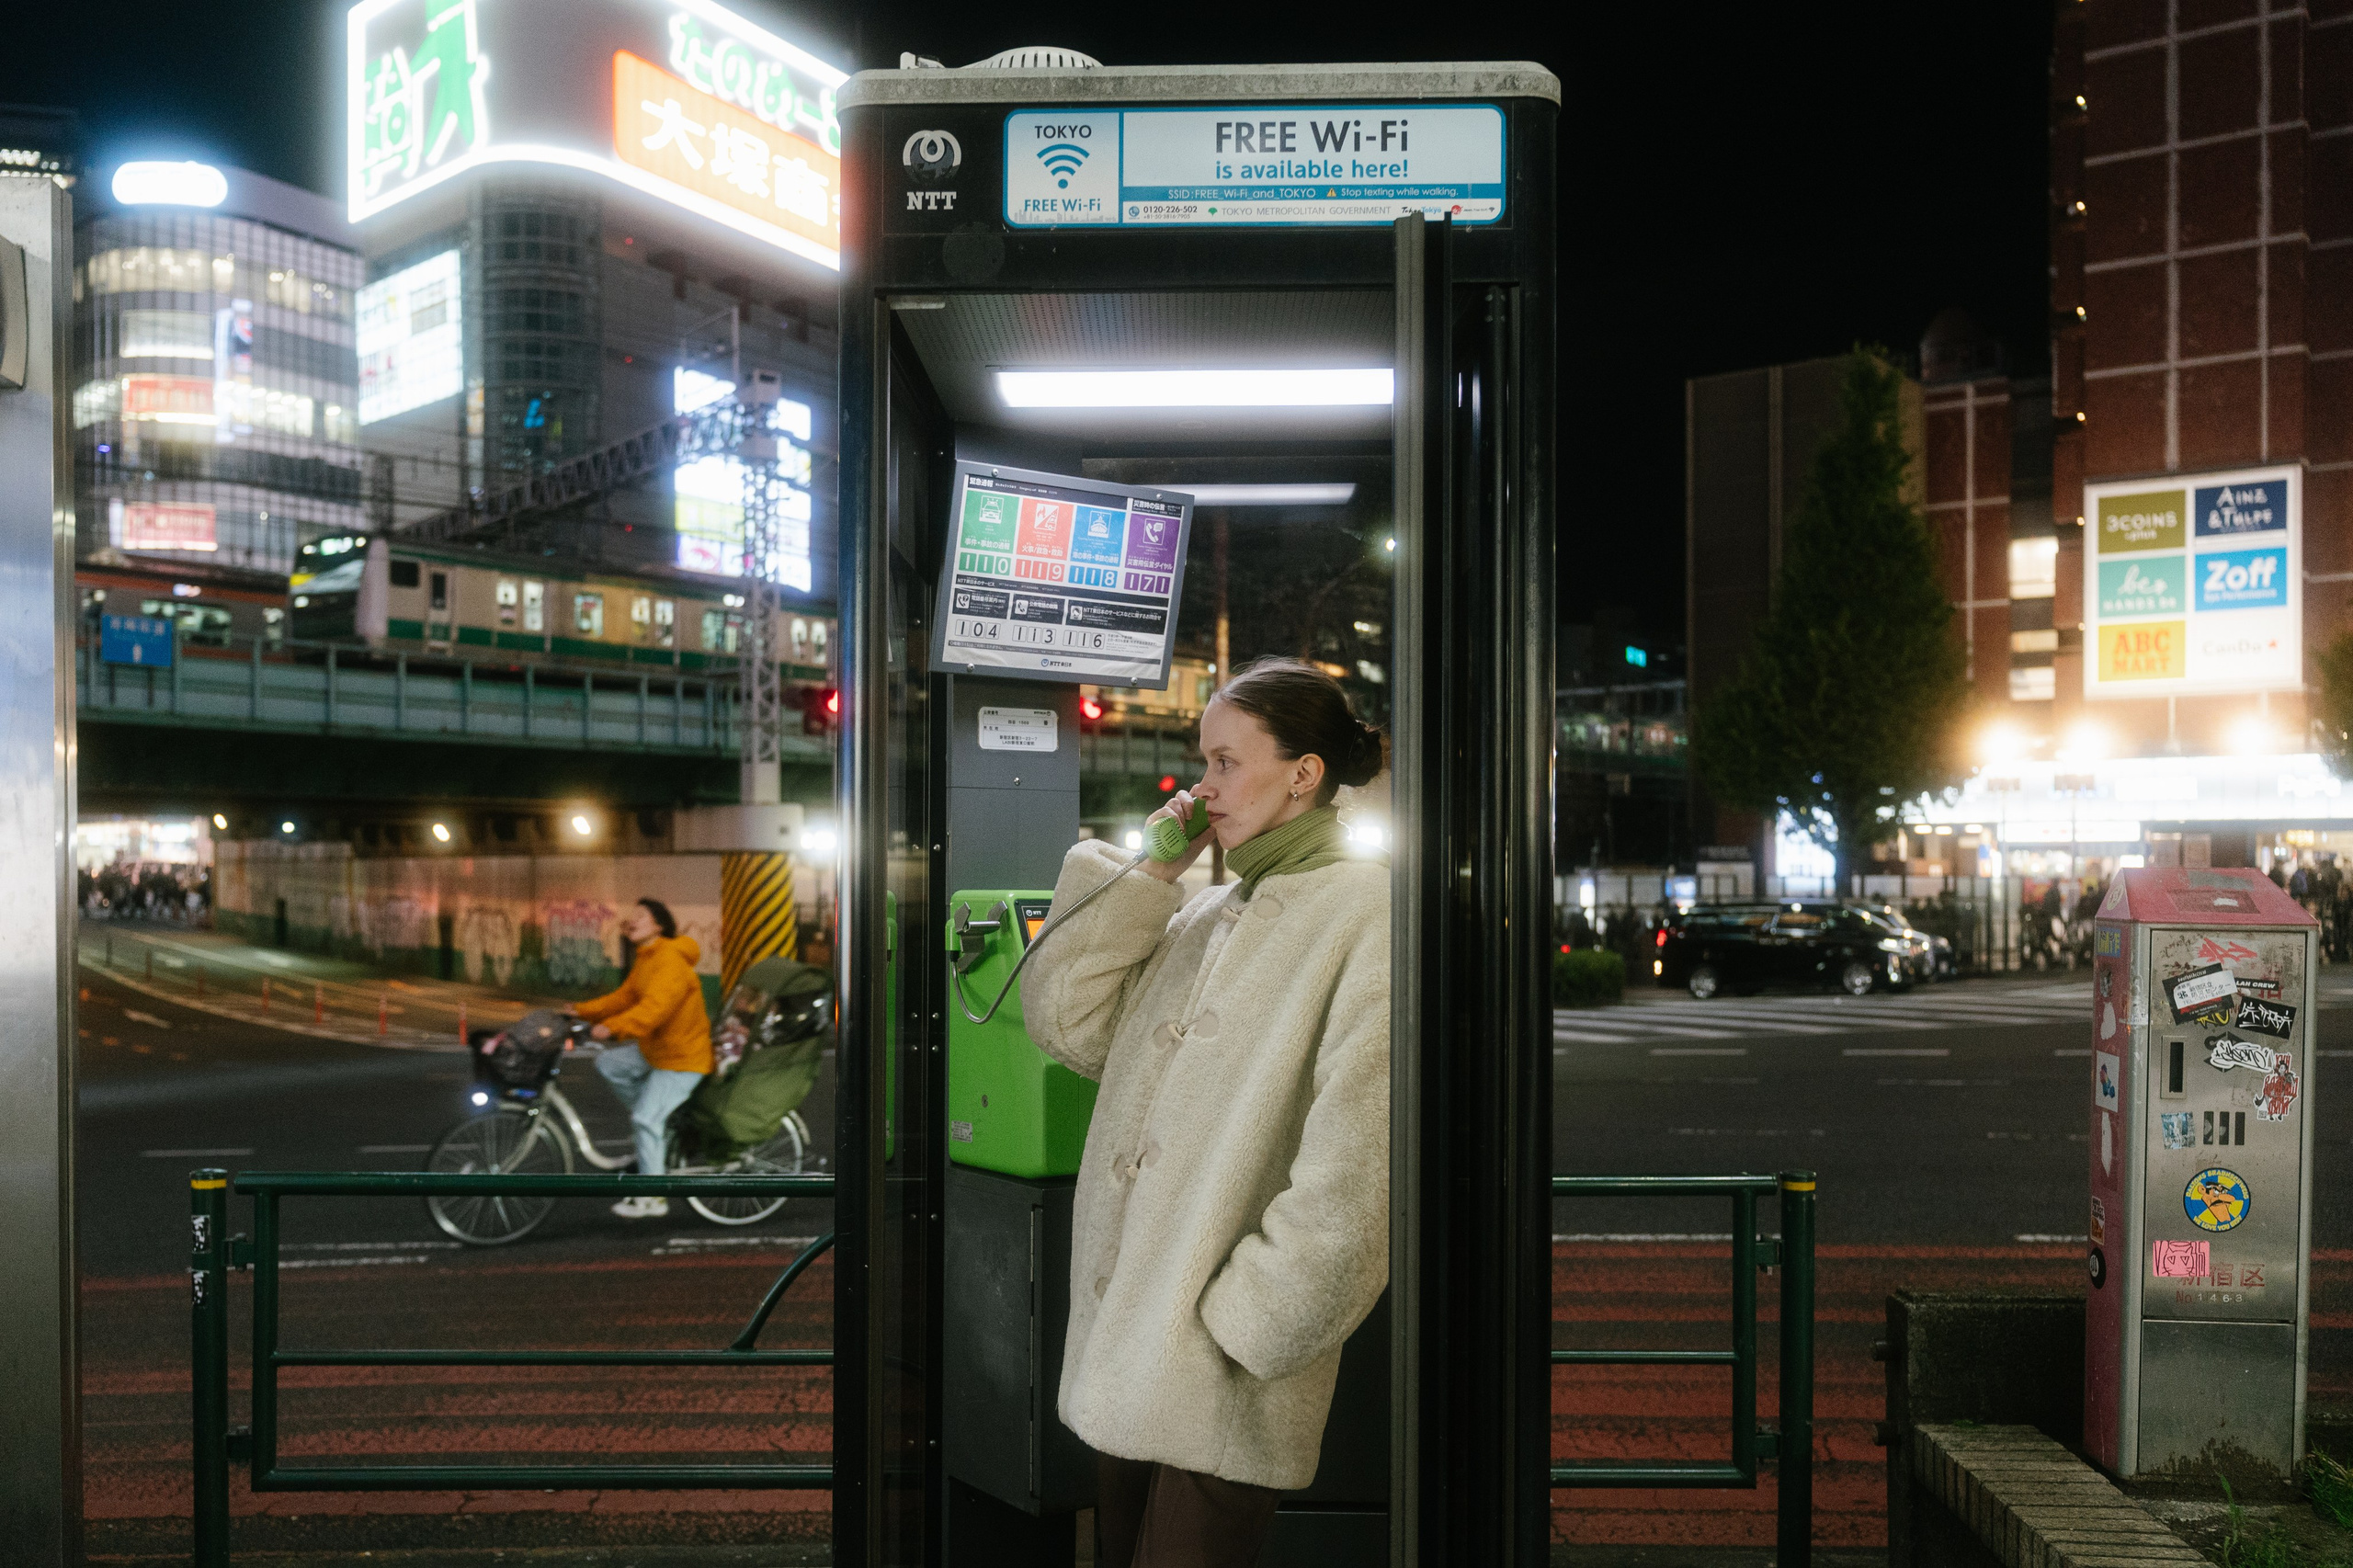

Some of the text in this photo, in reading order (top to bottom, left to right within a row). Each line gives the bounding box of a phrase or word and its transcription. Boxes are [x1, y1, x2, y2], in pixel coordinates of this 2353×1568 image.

[1034, 125, 1092, 139] TOKYO
[1216, 119, 1408, 153] FREE Wi-Fi
[642, 98, 840, 233] 大塚商
[1216, 159, 1408, 179] is available here!
[906, 191, 957, 210] NTT
[1341, 187, 1459, 198] Stop texting while walking.
[1024, 199, 1101, 212] FREE Wi-Fi
[1143, 205, 1198, 214] 0120-226-502
[1222, 206, 1392, 215] TOKYO METROPOLITAN GOVERNMENT
[966, 554, 1008, 574] 110
[1021, 561, 1062, 580] 119
[1074, 568, 1115, 586] 118
[2204, 555, 2278, 592] Zoff
[1130, 574, 1165, 592] 171
[961, 621, 997, 638] 104
[1018, 627, 1053, 643] 113
[1068, 631, 1102, 648] 116
[2114, 629, 2171, 654] ABC
[2114, 657, 2171, 673] MART
